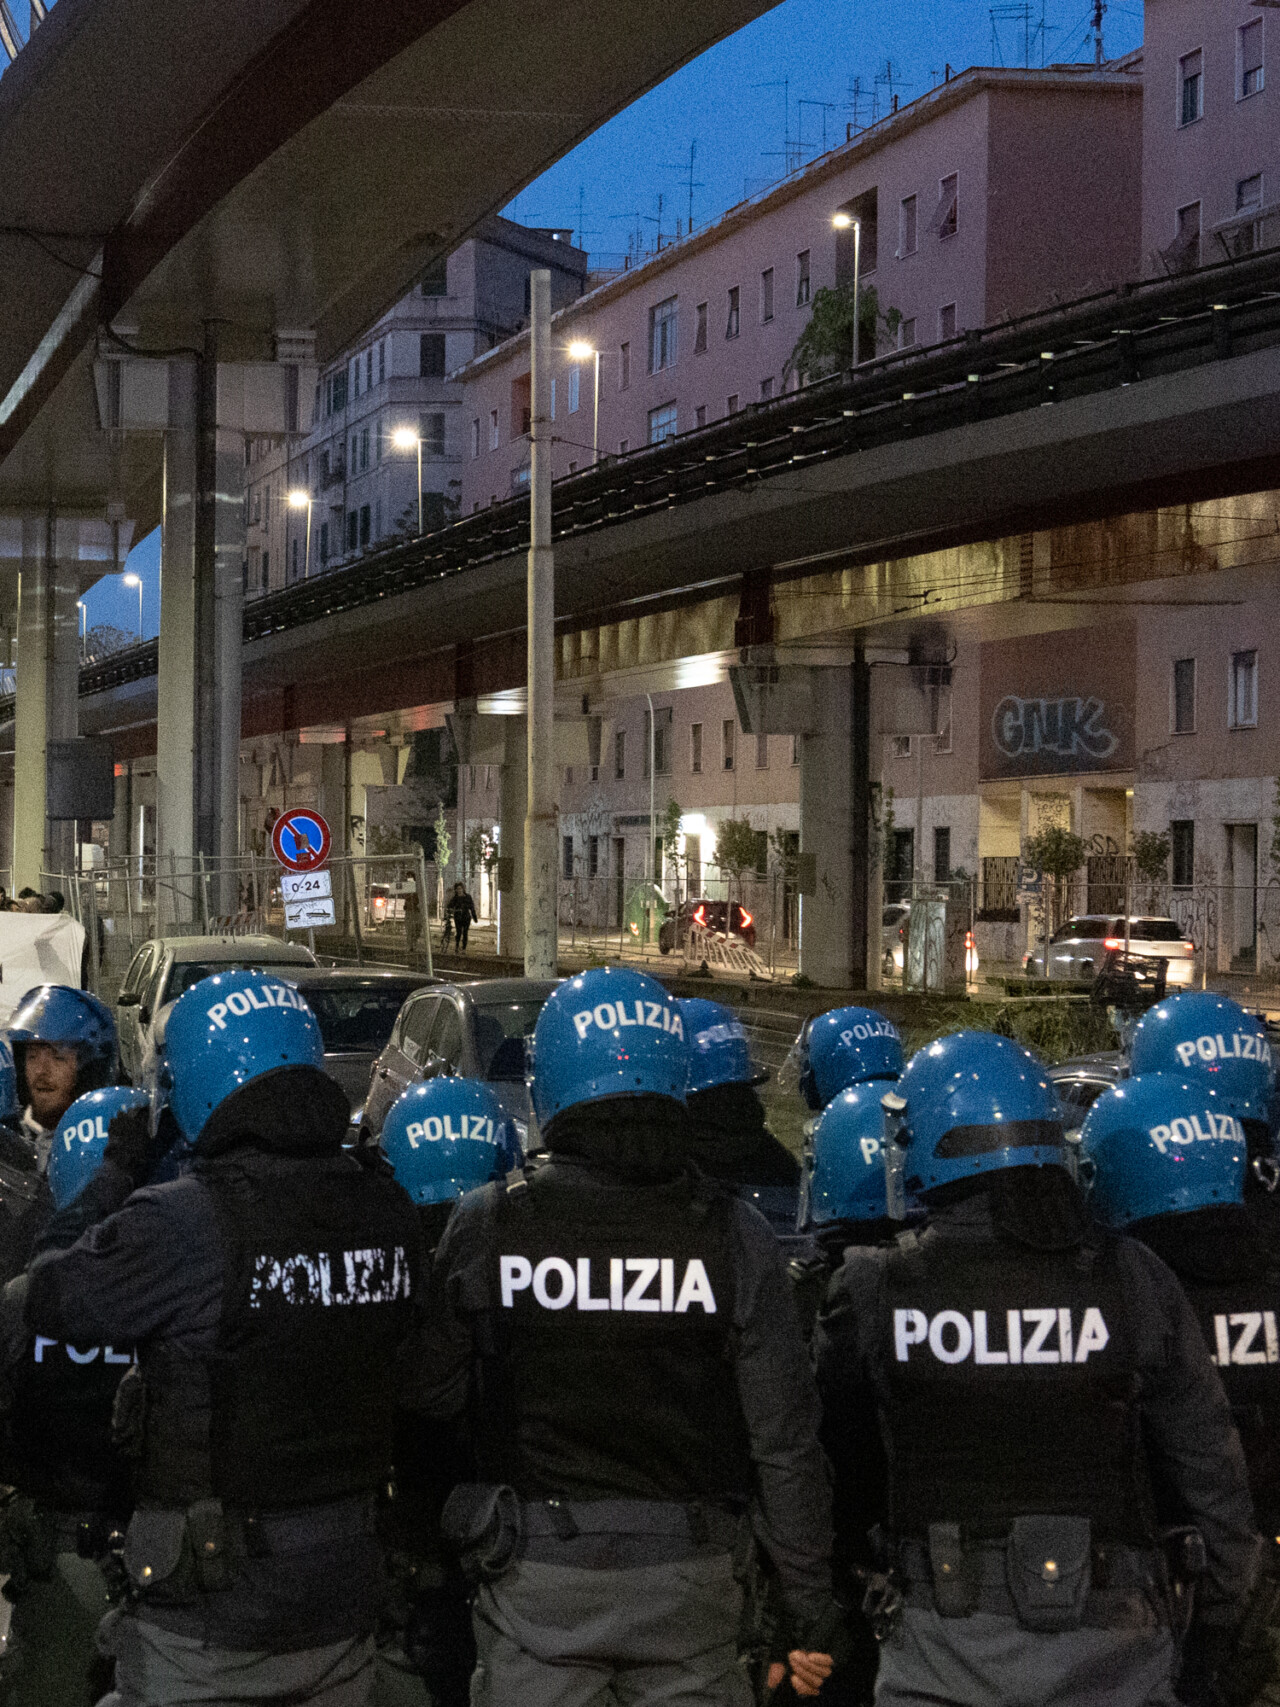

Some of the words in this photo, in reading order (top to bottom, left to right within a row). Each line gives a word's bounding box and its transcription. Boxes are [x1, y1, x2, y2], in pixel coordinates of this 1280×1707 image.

[291, 880, 320, 893] 0-24
[573, 1000, 684, 1042] POLIZIA
[1175, 1033, 1272, 1067] POLIZIA
[405, 1115, 507, 1150] POLIZIA
[500, 1255, 717, 1313] POLIZIA
[894, 1307, 1110, 1365] POLIZIA
